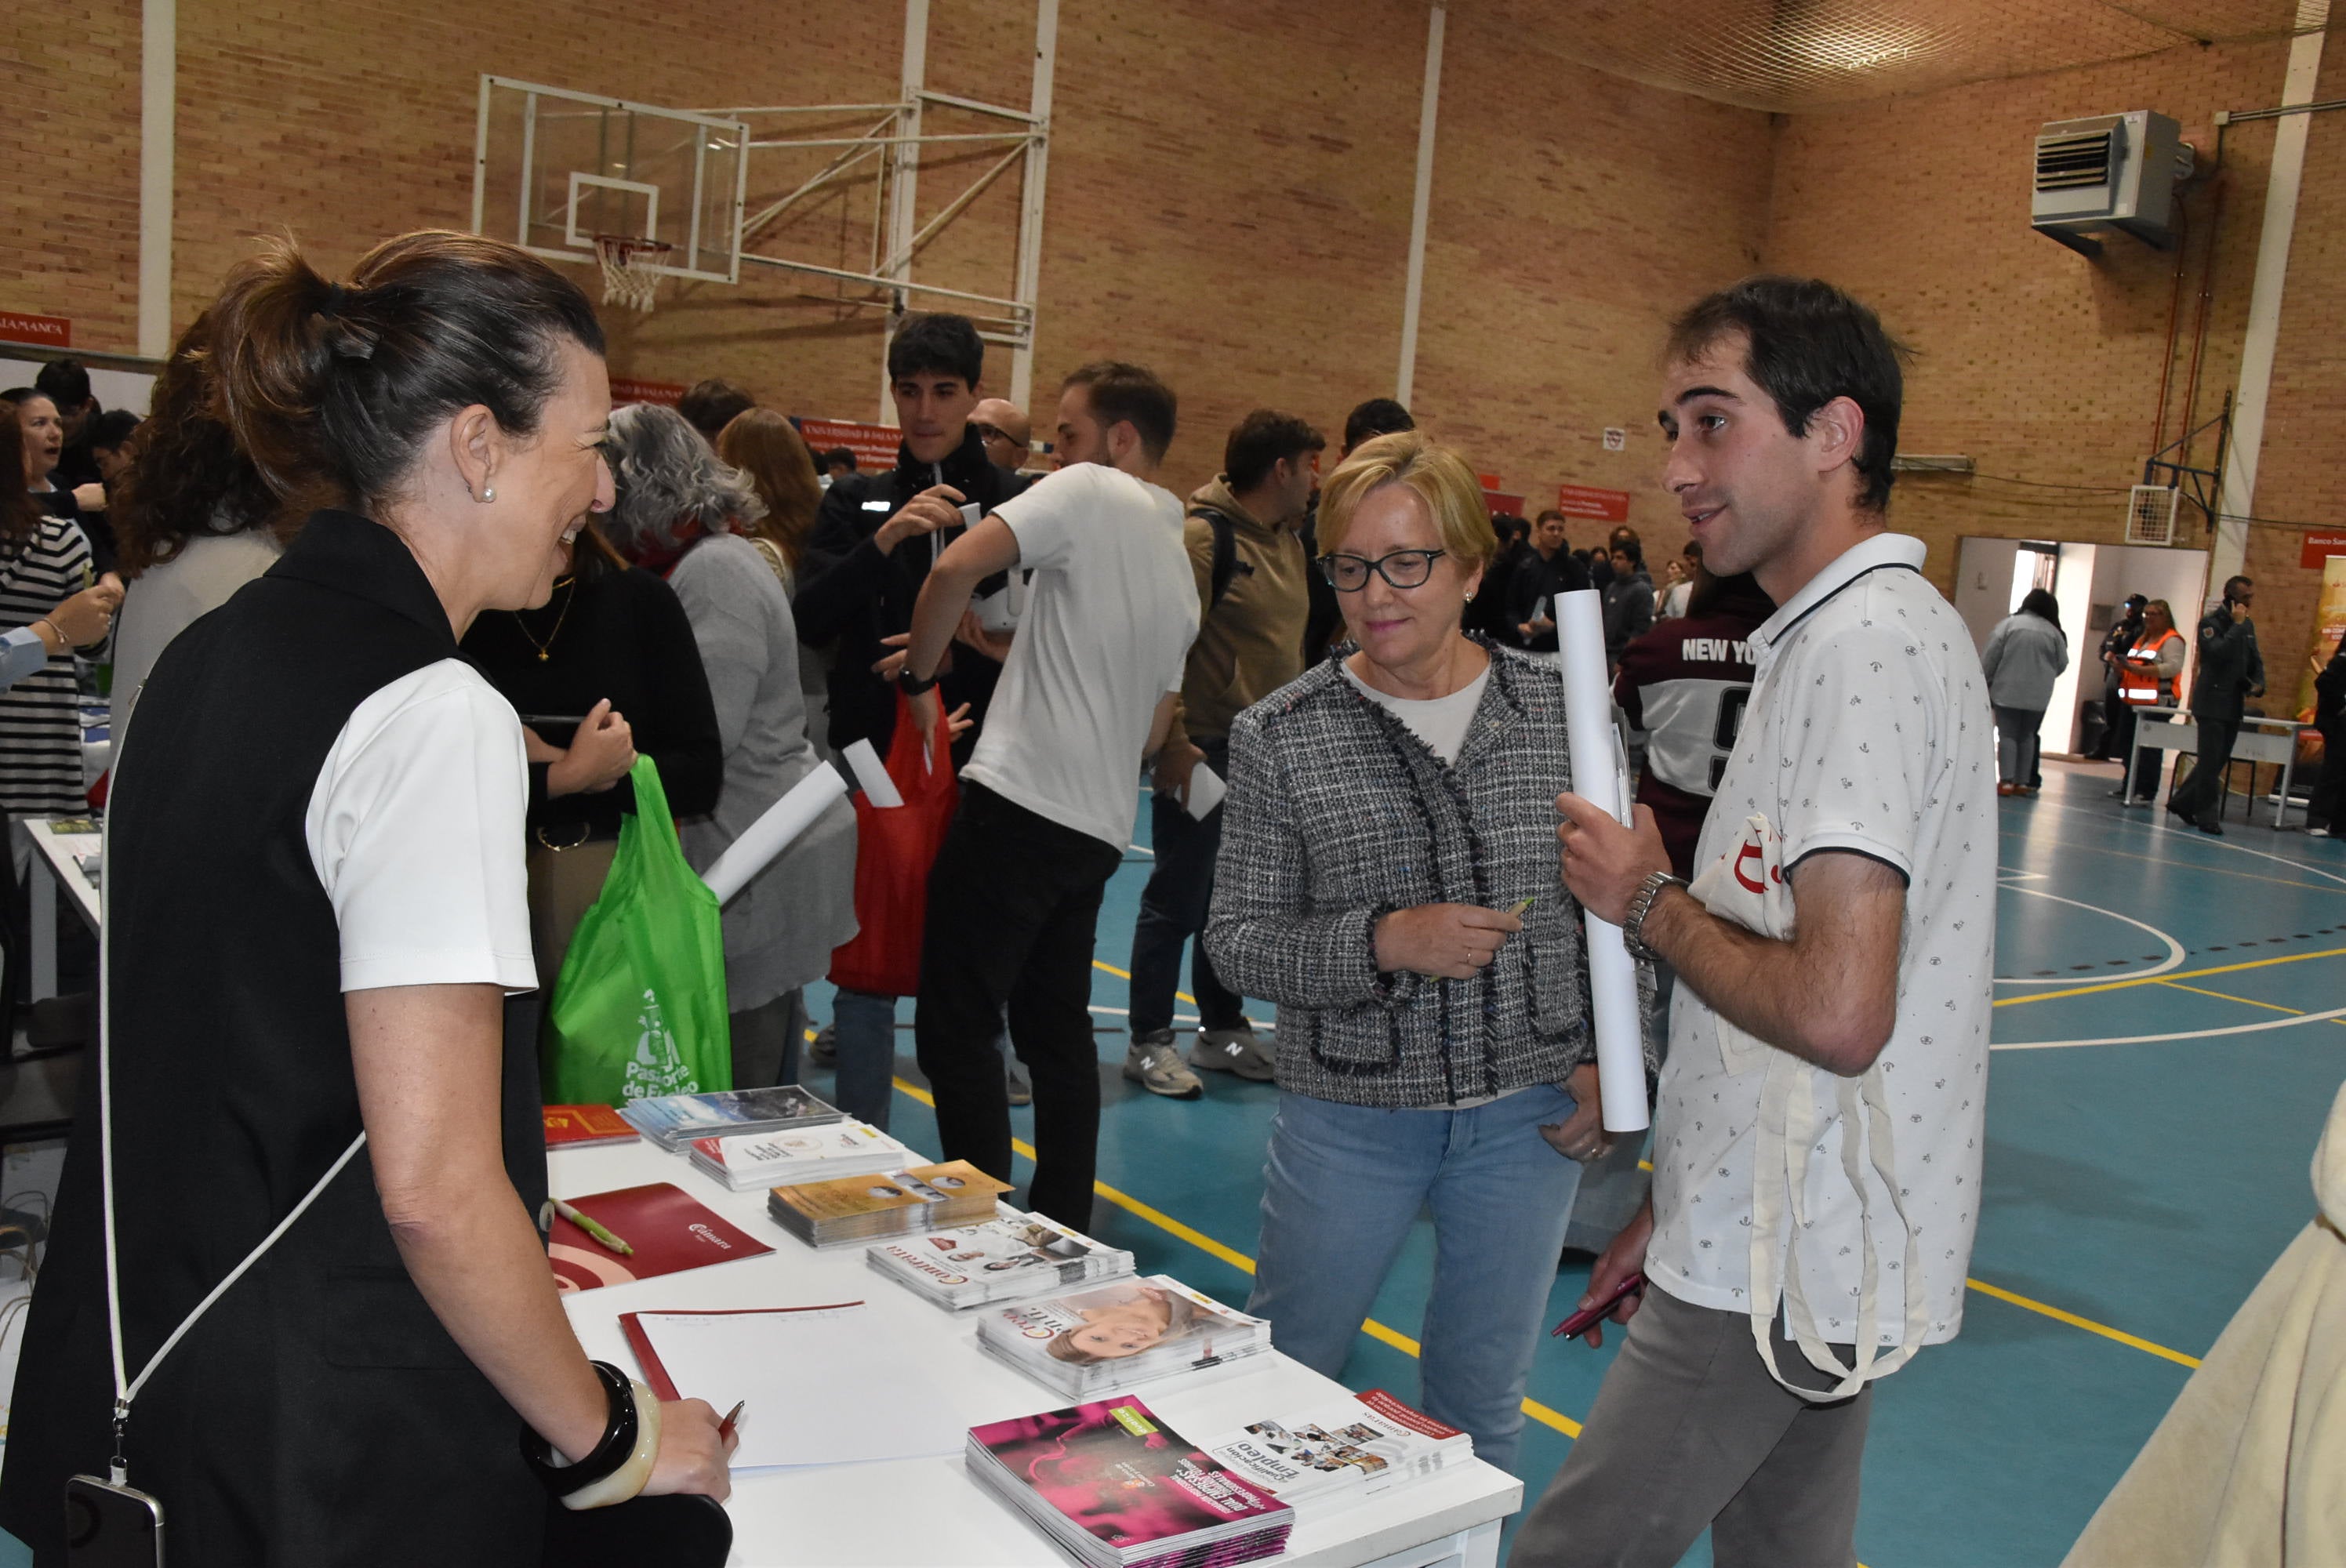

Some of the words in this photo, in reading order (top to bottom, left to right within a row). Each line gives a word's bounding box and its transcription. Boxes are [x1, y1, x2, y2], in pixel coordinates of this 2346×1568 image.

[2308, 536, 2332, 545] Banco
[1682, 637, 1729, 662] NEW
[622, 1080, 645, 1098] de
[886, 1245, 968, 1284] Contrata
[1003, 1314, 1055, 1339] Cree
[1226, 1447, 1286, 1481] Cualificación
[1237, 1443, 1300, 1477] Empleo
[1220, 1497, 1248, 1512] DUAL
